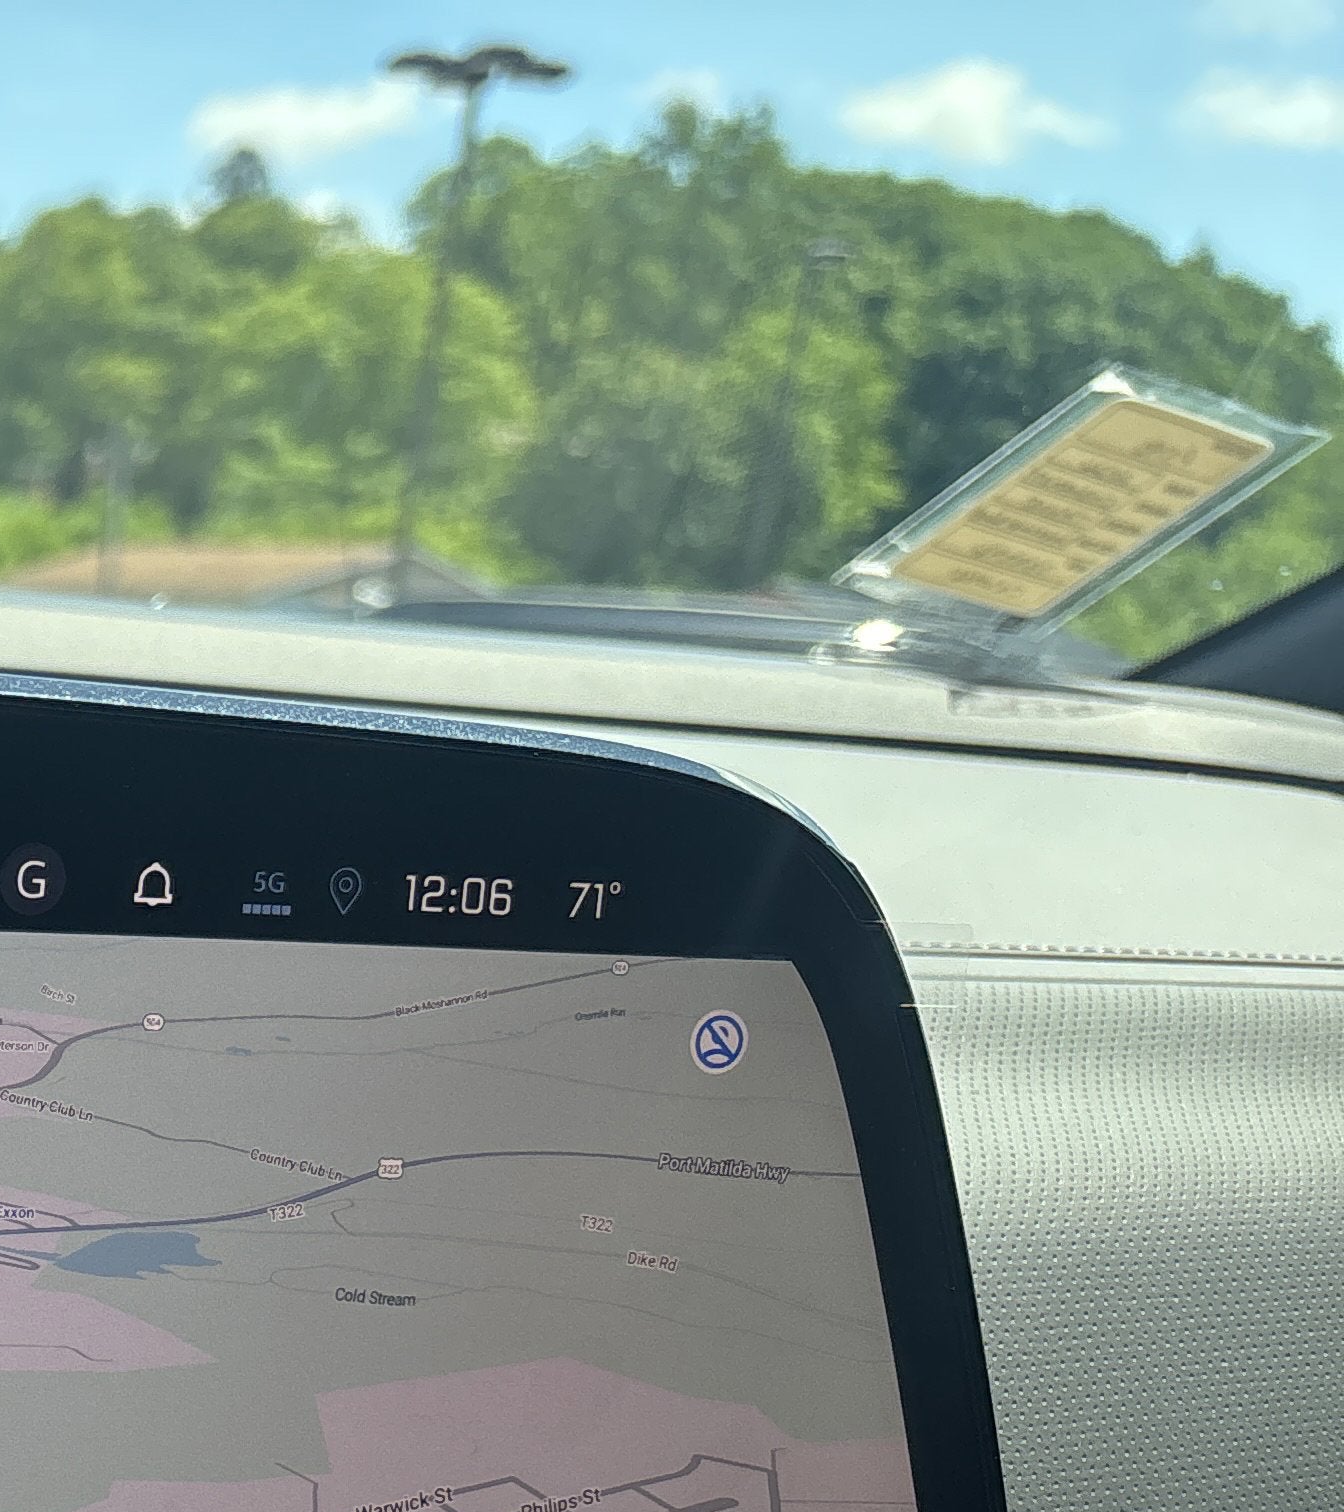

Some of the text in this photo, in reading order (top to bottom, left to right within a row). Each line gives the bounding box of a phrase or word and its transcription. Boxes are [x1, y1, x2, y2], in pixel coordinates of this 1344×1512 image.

[16, 861, 46, 898] G
[254, 871, 285, 893] 5G
[405, 874, 513, 916] 12:06
[568, 881, 621, 918] 71°
[37, 1042, 49, 1051] Dr
[0, 1090, 93, 1120] Country Club Ln
[250, 1149, 343, 1181] Country Club Ln
[658, 1153, 790, 1183] Port Matilda Hwy
[269, 1204, 303, 1220] T322
[581, 1216, 613, 1232] T322
[627, 1251, 678, 1272] Dike Rd
[335, 1287, 416, 1307] Cold Stream
[434, 1488, 453, 1504] St
